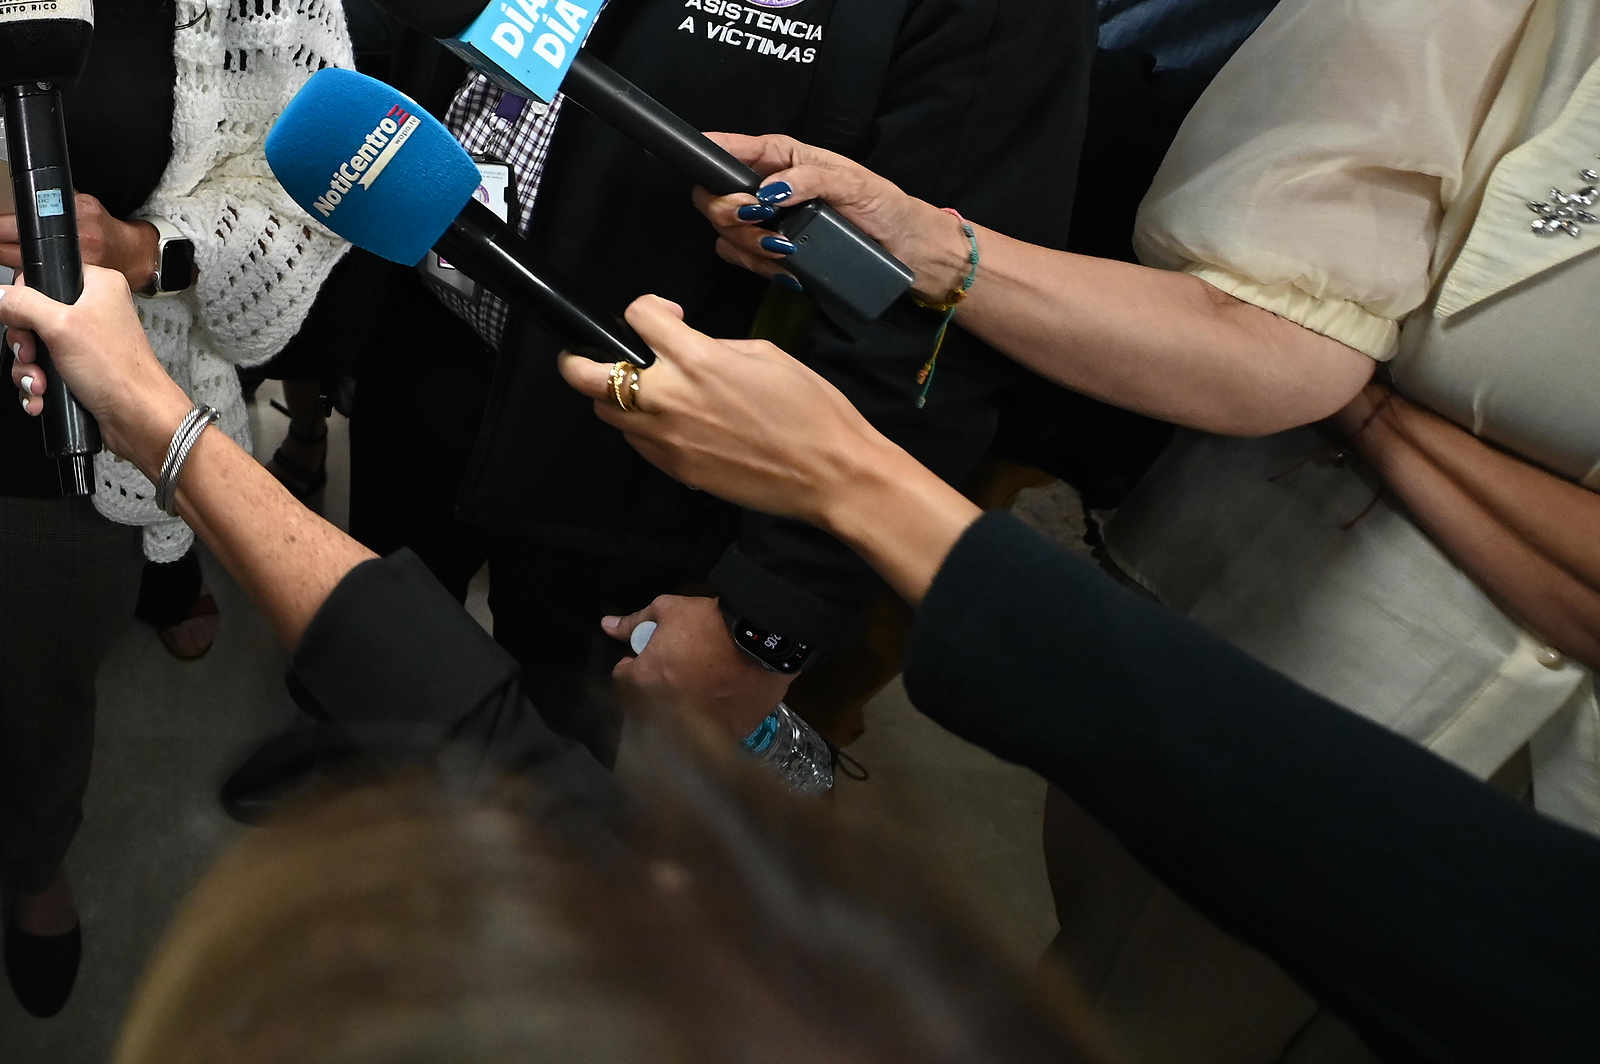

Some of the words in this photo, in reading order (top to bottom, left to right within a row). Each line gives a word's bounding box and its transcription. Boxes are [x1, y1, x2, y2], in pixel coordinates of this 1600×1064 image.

[31, 3, 57, 12] RICO
[677, 16, 695, 34] A
[706, 21, 817, 64] VÍCTIMAS
[394, 117, 417, 145] wapa.tv
[312, 117, 398, 218] NotiCentro
[140, 192, 206, 254] EXIT
